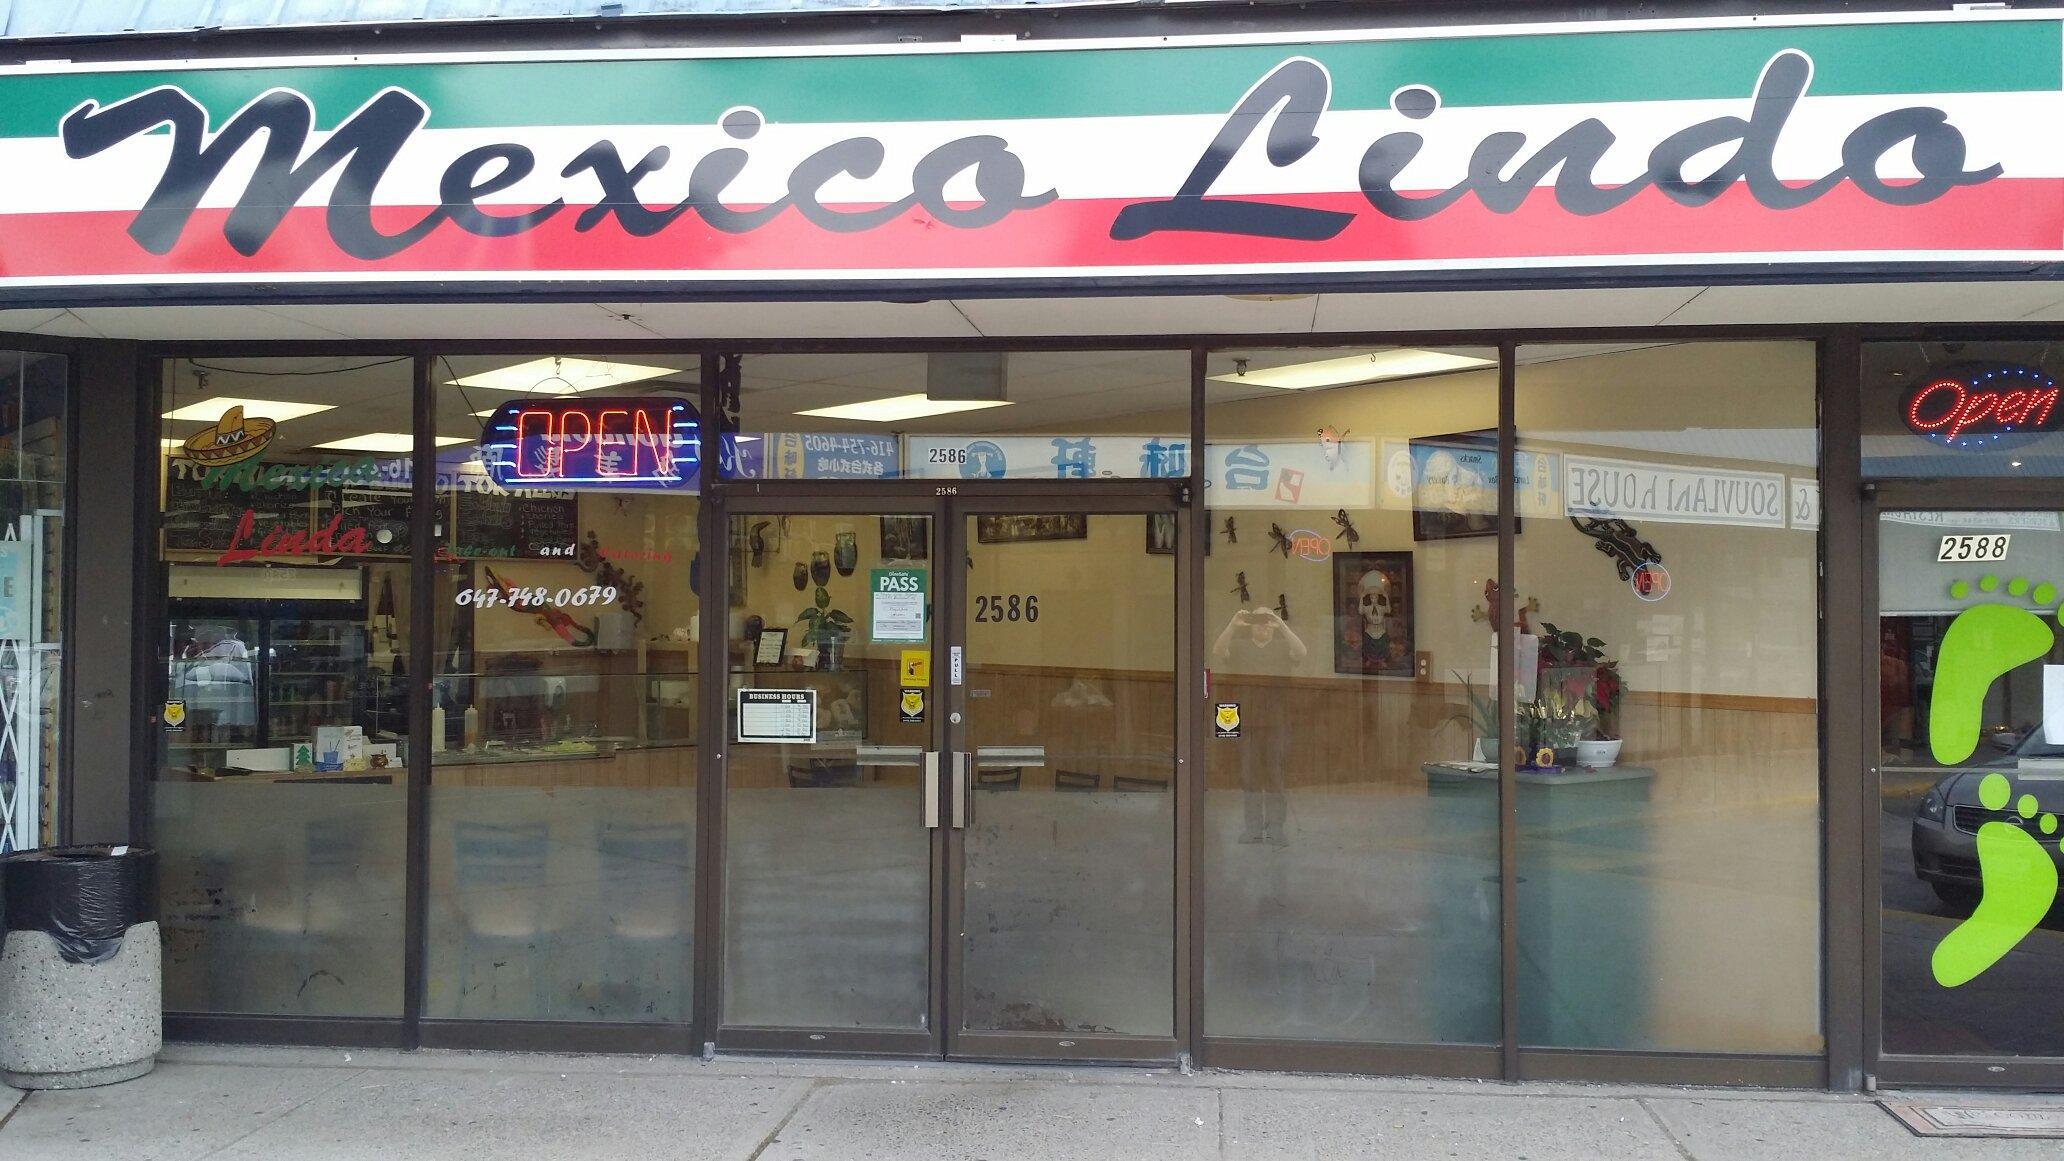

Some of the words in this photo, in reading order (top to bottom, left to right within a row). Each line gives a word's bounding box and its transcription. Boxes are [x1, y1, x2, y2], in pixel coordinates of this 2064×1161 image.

[60, 86, 1058, 259] Mexico
[1109, 49, 2003, 241] Lindo
[1910, 380, 2060, 443] Open
[517, 408, 673, 478] OPEN
[929, 448, 966, 464] 2586
[935, 487, 957, 496] 2586
[540, 543, 575, 556] and
[1940, 536, 2007, 560] 2588
[879, 576, 919, 592] PASS
[455, 585, 617, 609] 647-748-0679
[975, 594, 1039, 623] 2586
